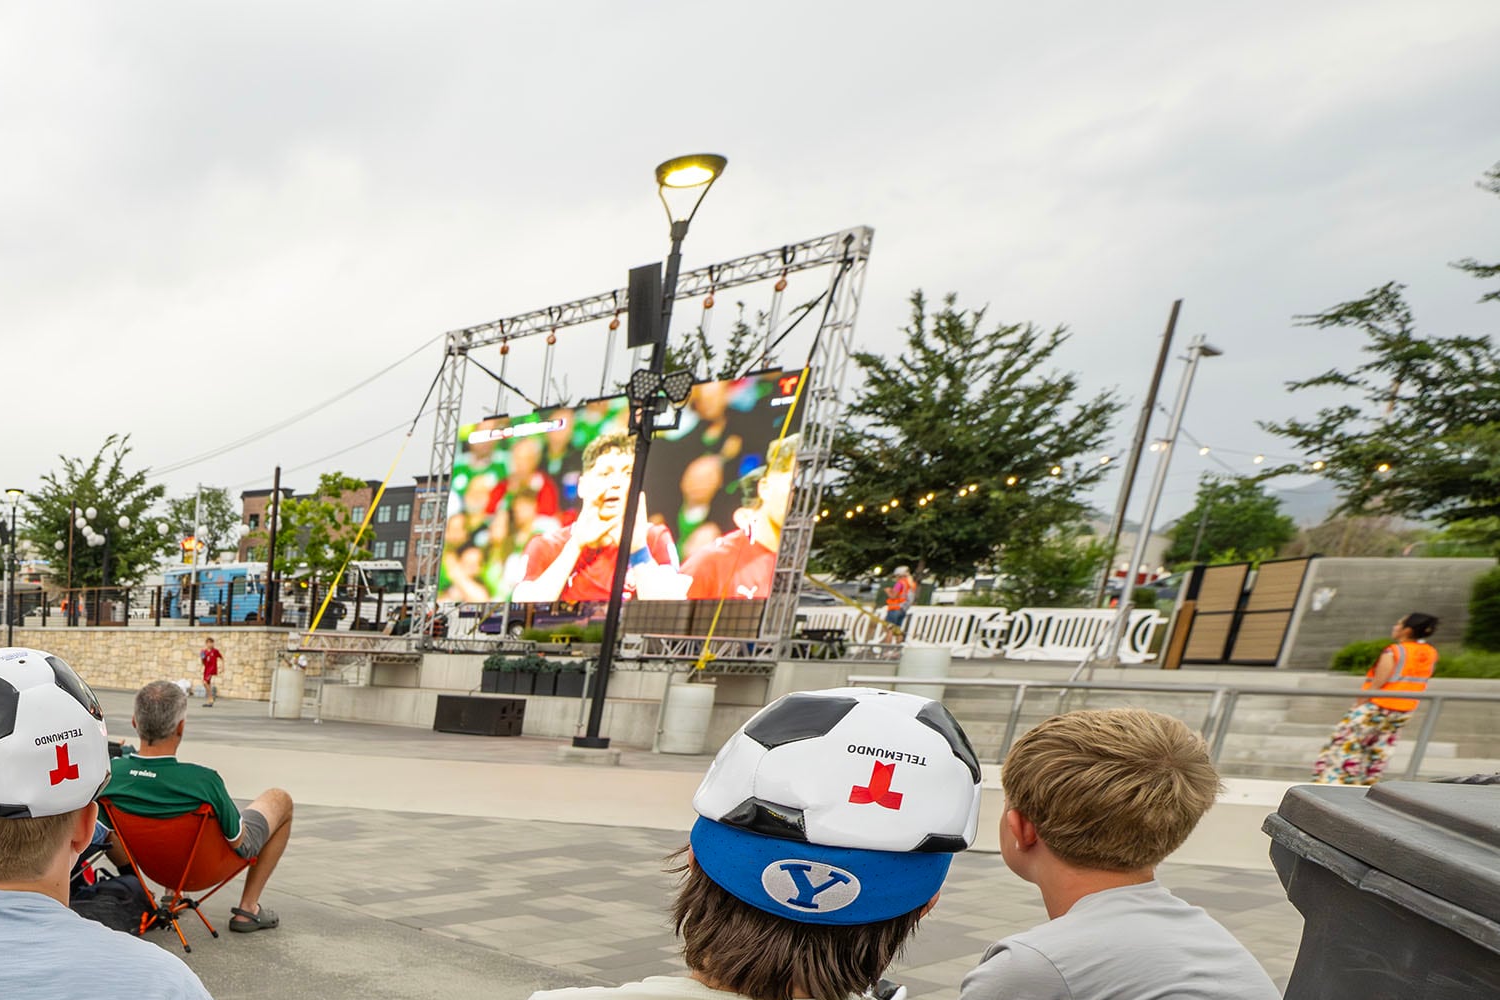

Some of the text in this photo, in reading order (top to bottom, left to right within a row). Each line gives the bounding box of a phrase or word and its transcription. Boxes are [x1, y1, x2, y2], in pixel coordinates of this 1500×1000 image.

[35, 728, 83, 746] TELEMUNDO
[847, 744, 927, 767] TELEMUNDO
[779, 863, 851, 909] Y
